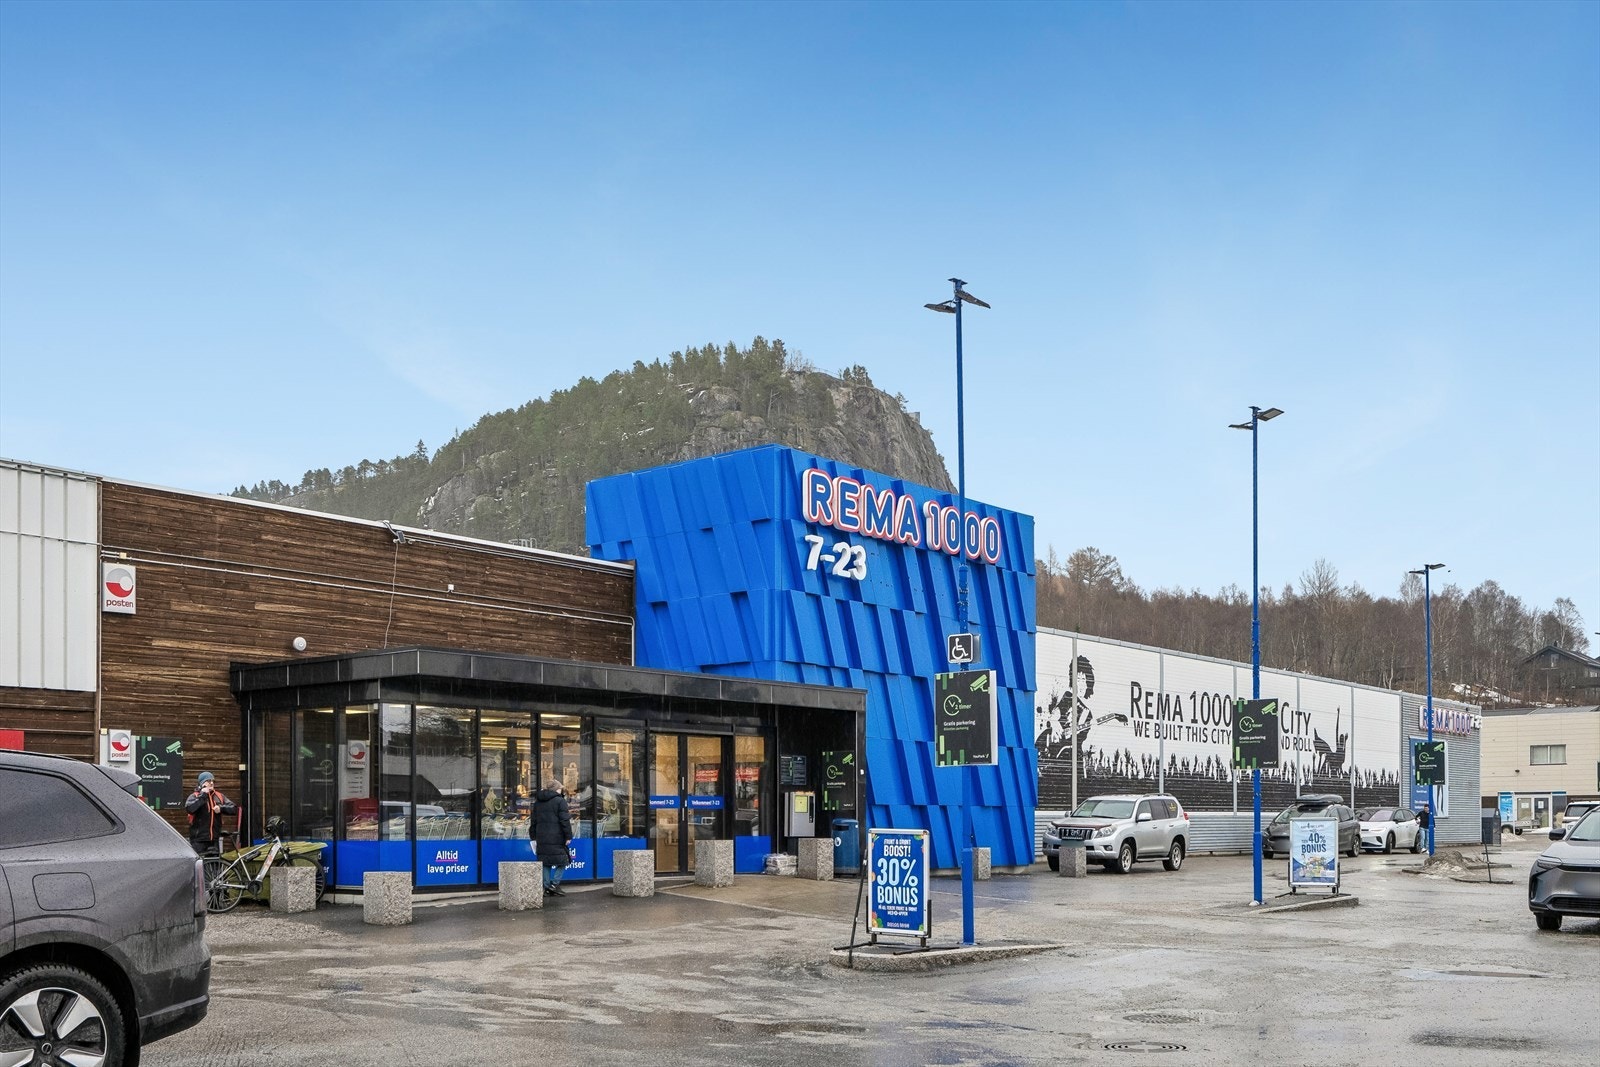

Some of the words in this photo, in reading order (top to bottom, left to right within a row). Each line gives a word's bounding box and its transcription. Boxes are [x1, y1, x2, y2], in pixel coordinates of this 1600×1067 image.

[803, 468, 921, 547] REMA
[923, 501, 1000, 564] 1000
[805, 534, 866, 580] 7-23
[106, 599, 134, 608] posten
[1189, 691, 1232, 727] 1000
[1134, 720, 1150, 738] WE
[1154, 723, 1183, 742] BUILT
[1185, 726, 1208, 743] THIS
[1211, 728, 1232, 745] CITY
[1293, 736, 1312, 752] ROLL
[1308, 832, 1327, 844] 40%
[436, 850, 458, 860] Alltid
[883, 845, 911, 857] BOOST!
[1301, 843, 1327, 854] BONUS
[427, 863, 444, 874] lave
[445, 863, 469, 875] priser
[877, 857, 919, 887] 30%
[877, 885, 918, 906] BONUS
